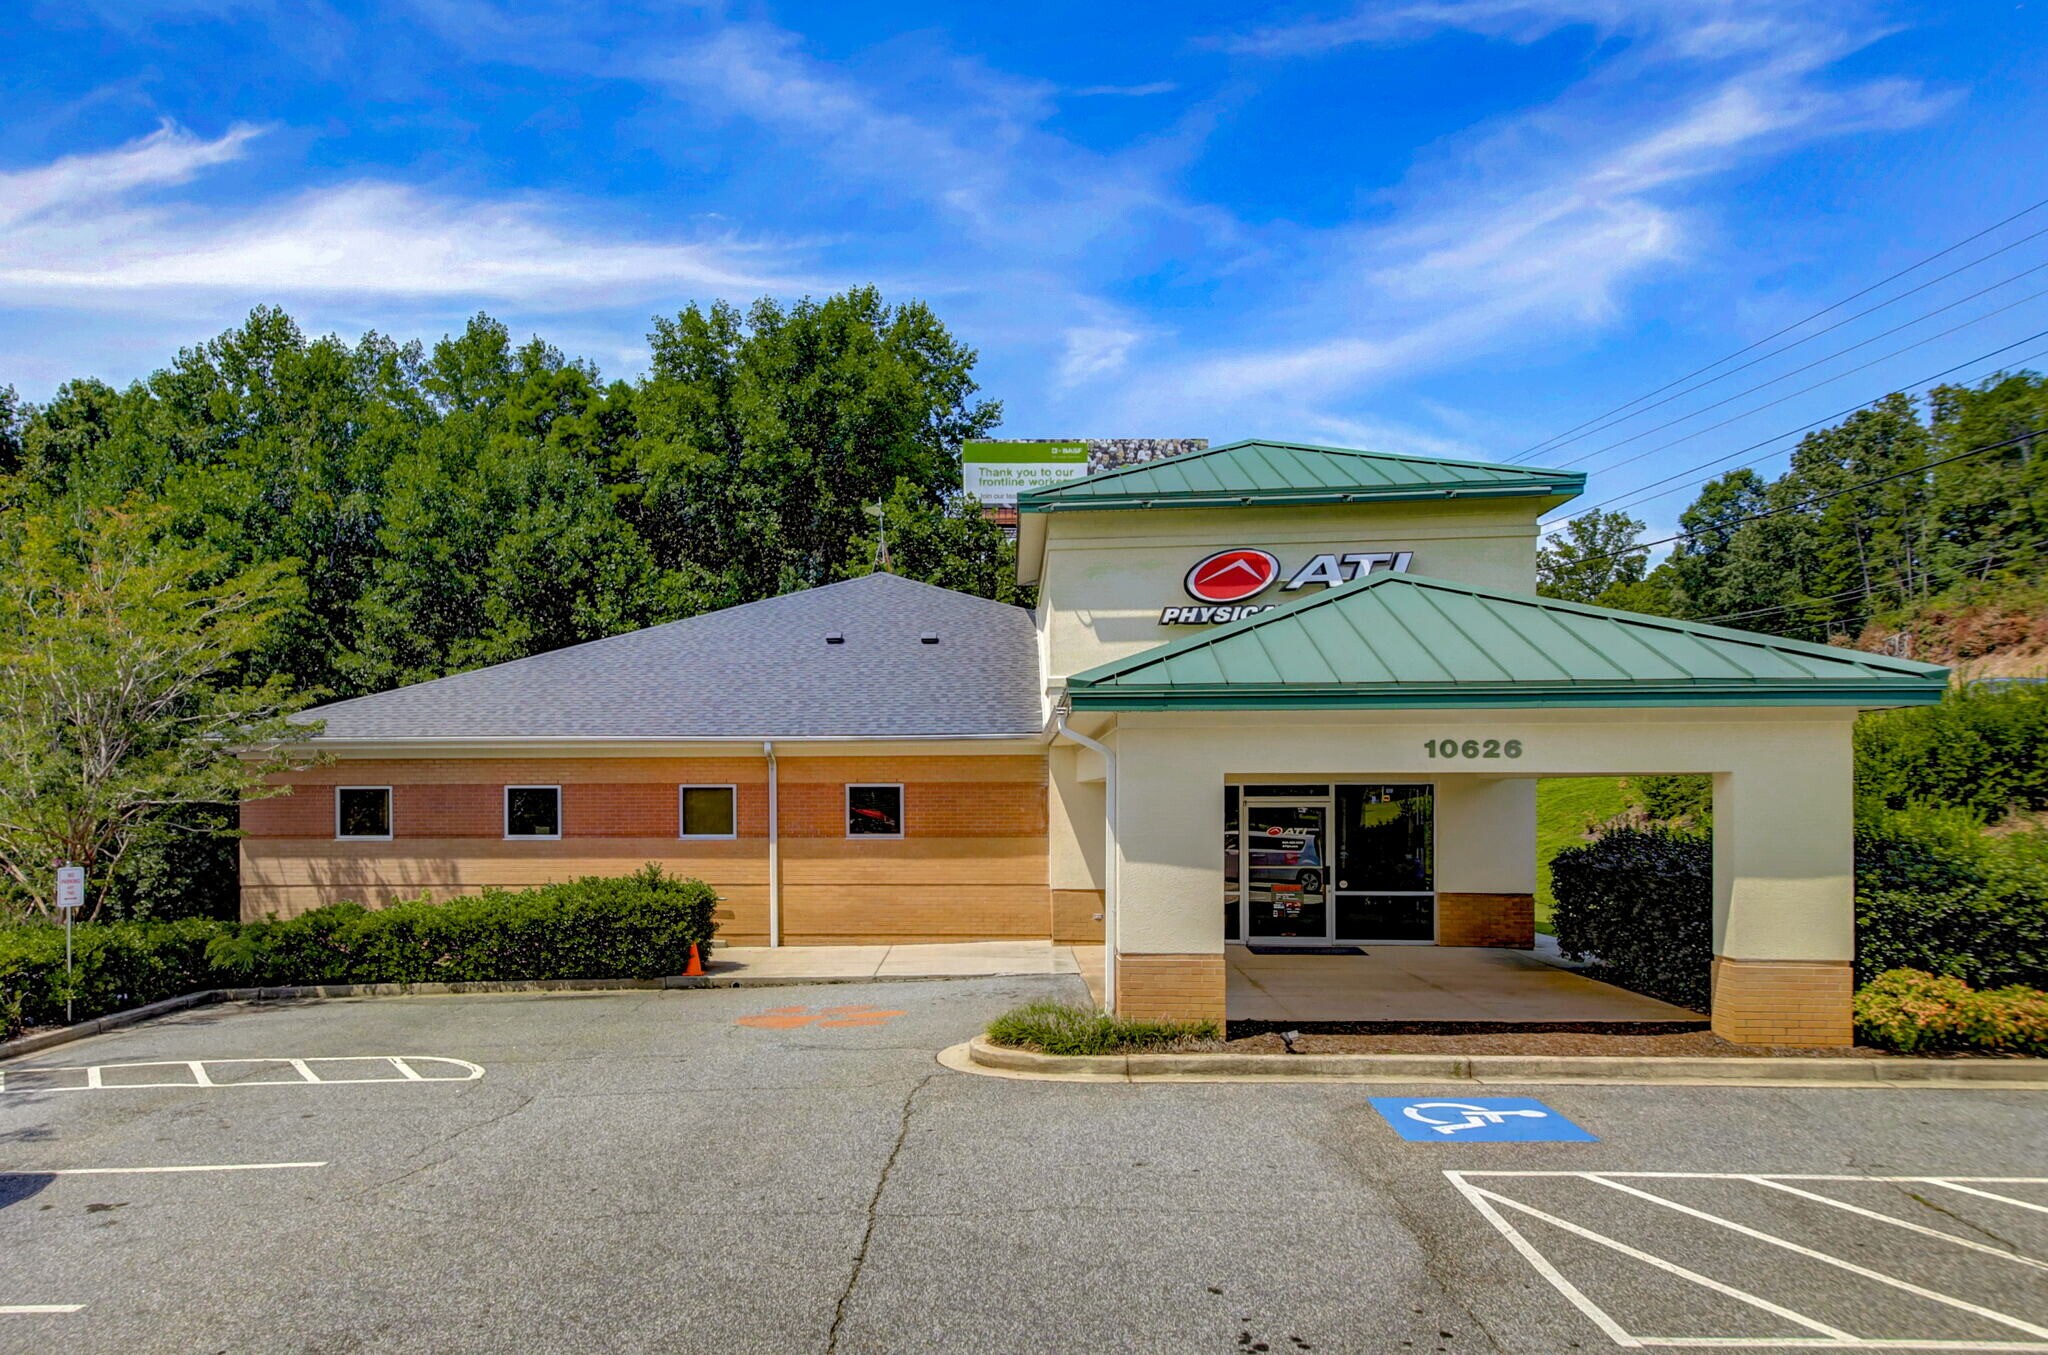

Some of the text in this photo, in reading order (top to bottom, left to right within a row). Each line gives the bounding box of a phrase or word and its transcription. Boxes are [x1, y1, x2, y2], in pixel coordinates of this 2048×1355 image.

[978, 467, 1074, 480] Thank you to our
[979, 477, 1025, 487] frontline
[1280, 551, 1414, 592] ATI
[1158, 604, 1281, 625] PHYSIC
[1424, 739, 1523, 759] 10626
[1283, 827, 1309, 836] ATI
